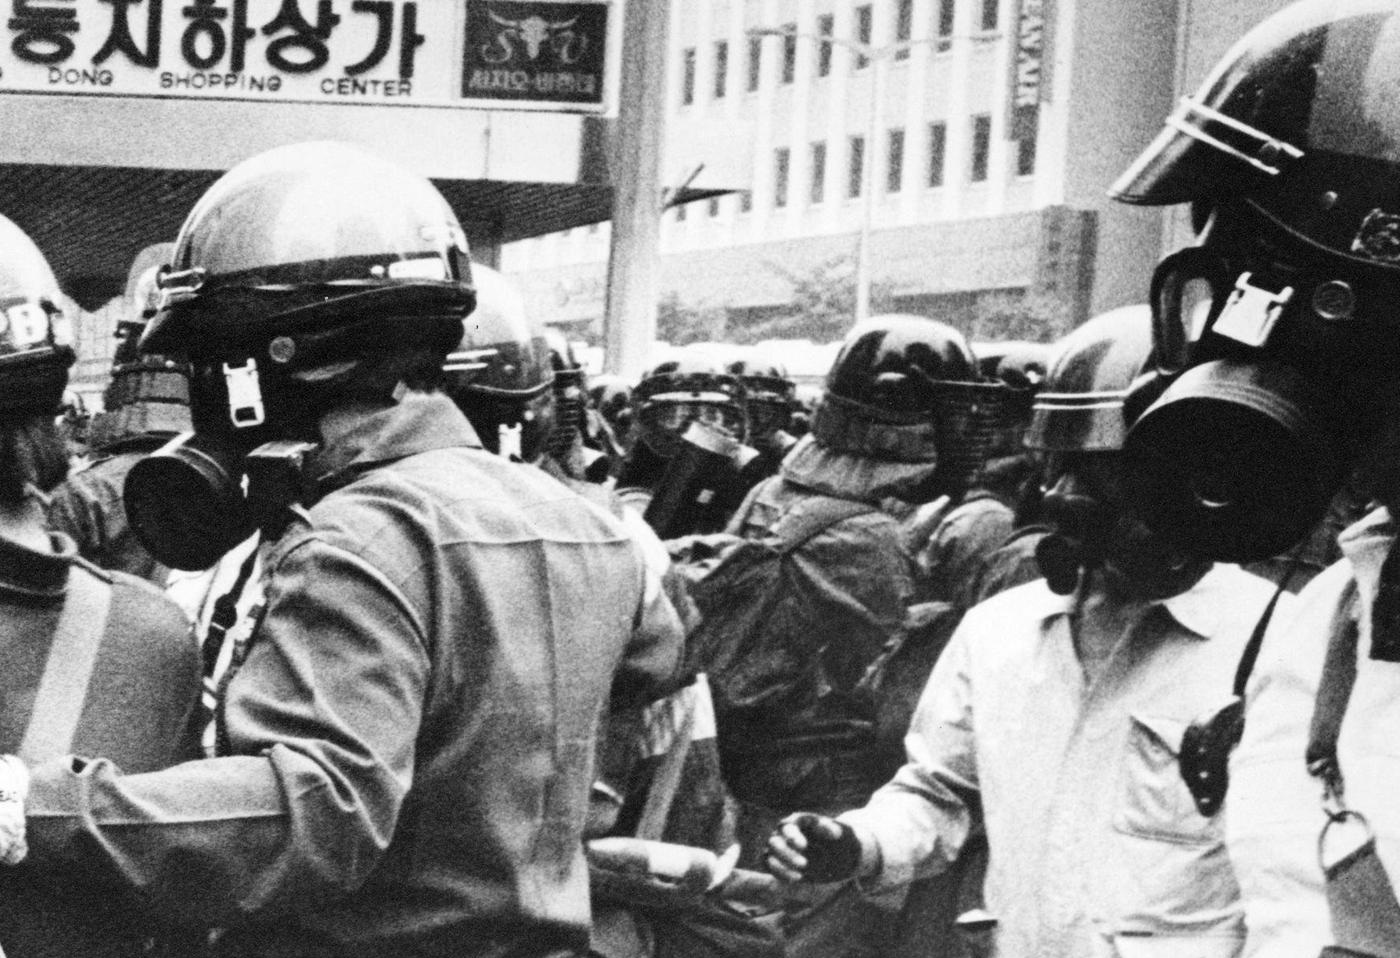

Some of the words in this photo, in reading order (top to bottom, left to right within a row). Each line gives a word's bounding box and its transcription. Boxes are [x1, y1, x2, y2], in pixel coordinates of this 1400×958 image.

[47, 66, 114, 86] DONG
[159, 71, 283, 92] SHOPPING
[319, 77, 413, 97] CENTER
